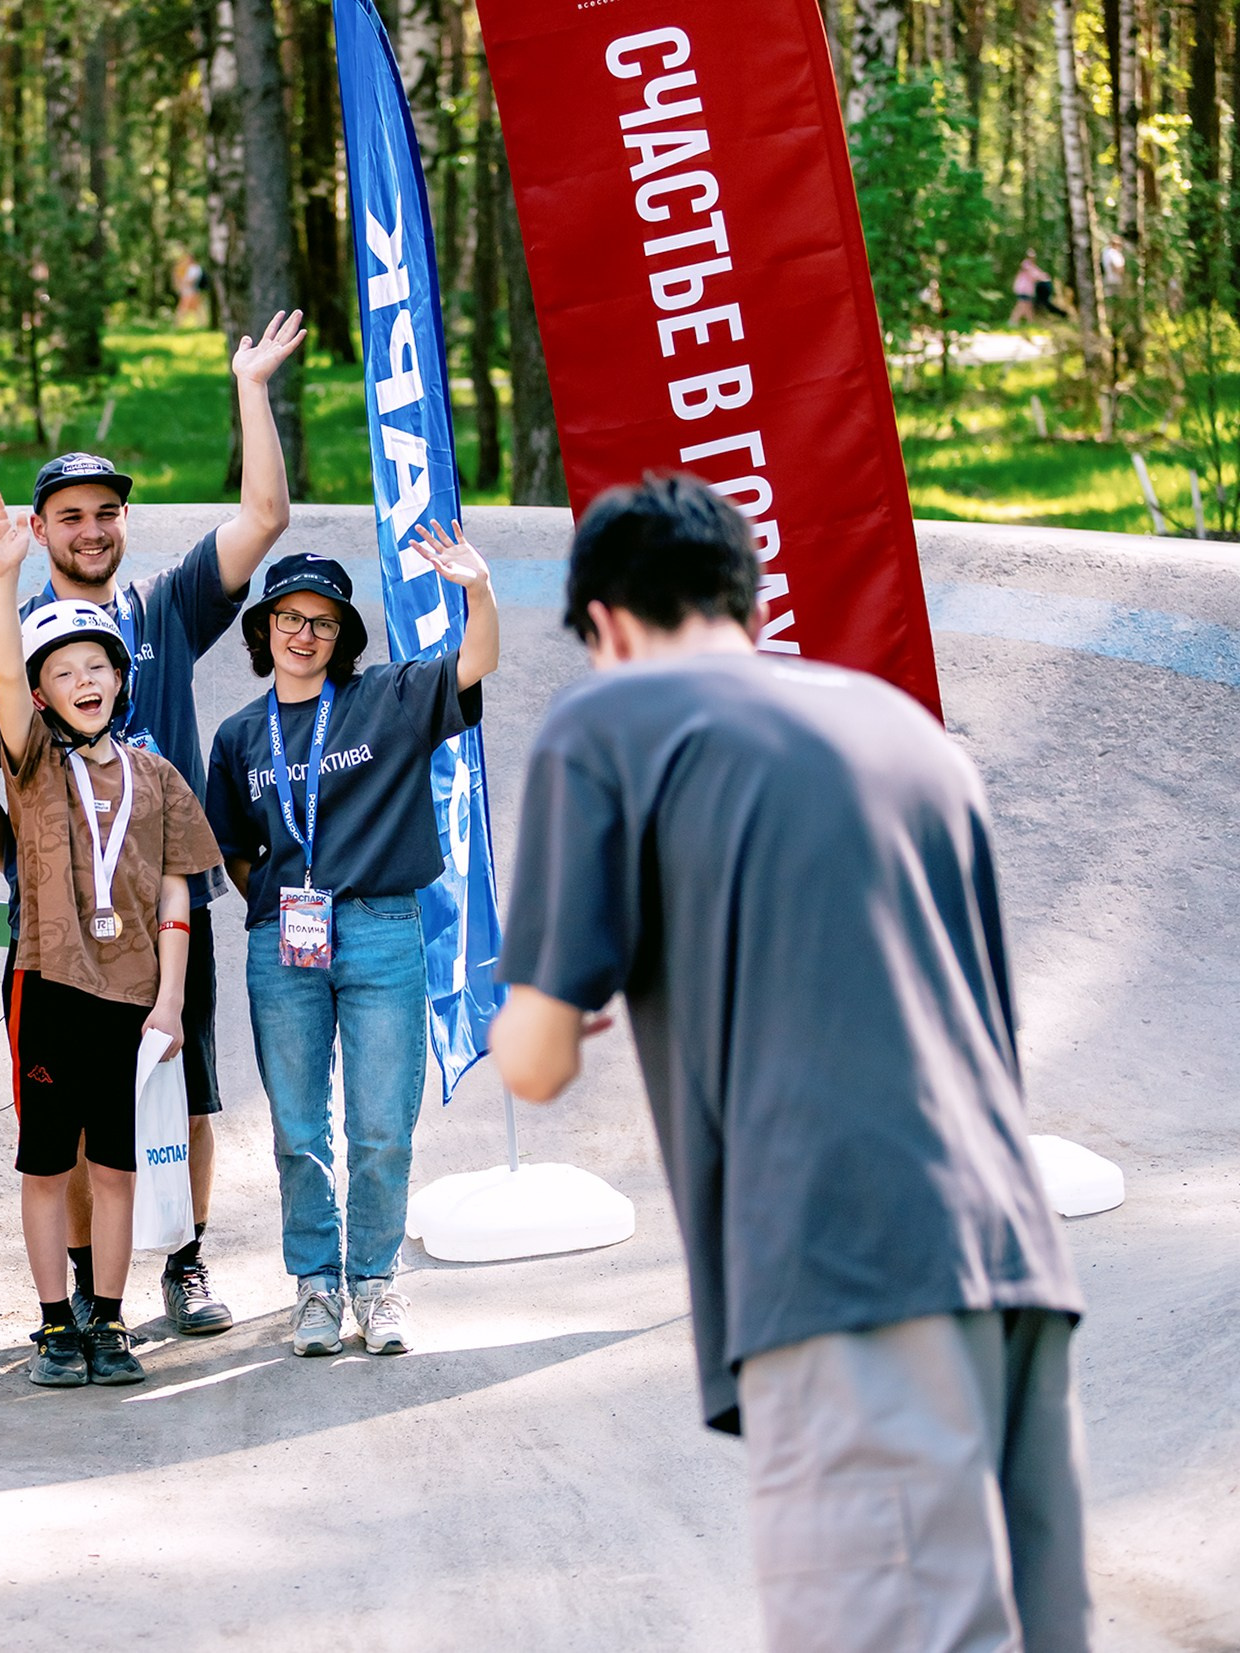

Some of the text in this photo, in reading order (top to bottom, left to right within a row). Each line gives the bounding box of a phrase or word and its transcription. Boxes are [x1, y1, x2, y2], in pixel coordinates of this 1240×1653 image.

[605, 26, 745, 358] СЧАСТЬЕ
[667, 363, 754, 421] В
[269, 712, 282, 757] РОСПАРК
[314, 700, 330, 746] РОСПАРК
[259, 743, 374, 788] песпктива
[283, 799, 304, 845] РОСПАРК
[307, 793, 317, 842] РОСПАРК
[288, 924, 326, 934] ПОЛИНА
[146, 1144, 187, 1166] РОСПАР
